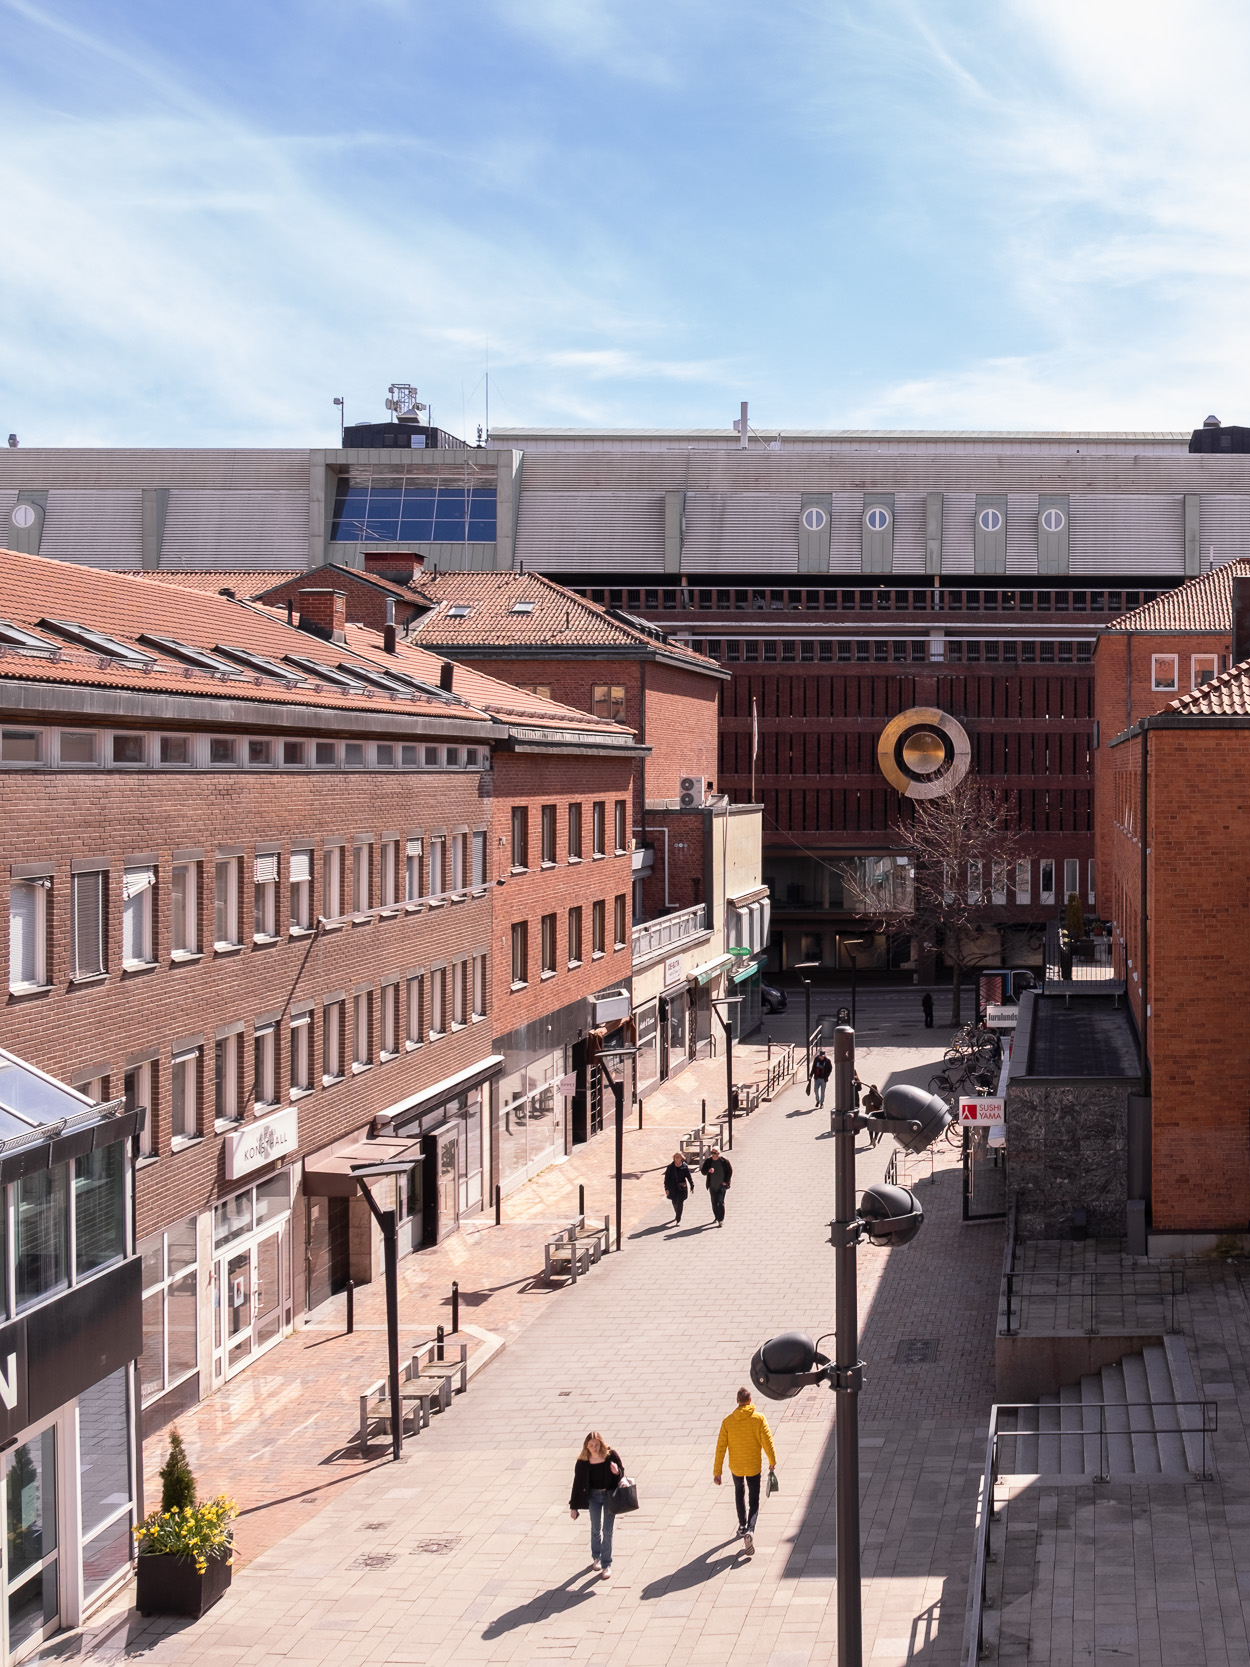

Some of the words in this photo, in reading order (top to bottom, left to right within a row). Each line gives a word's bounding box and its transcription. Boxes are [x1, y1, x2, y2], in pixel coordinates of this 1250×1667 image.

[979, 1104, 1001, 1112] SUSHI
[980, 1112, 1001, 1120] YAMA
[244, 1132, 288, 1161] KONSTHALL
